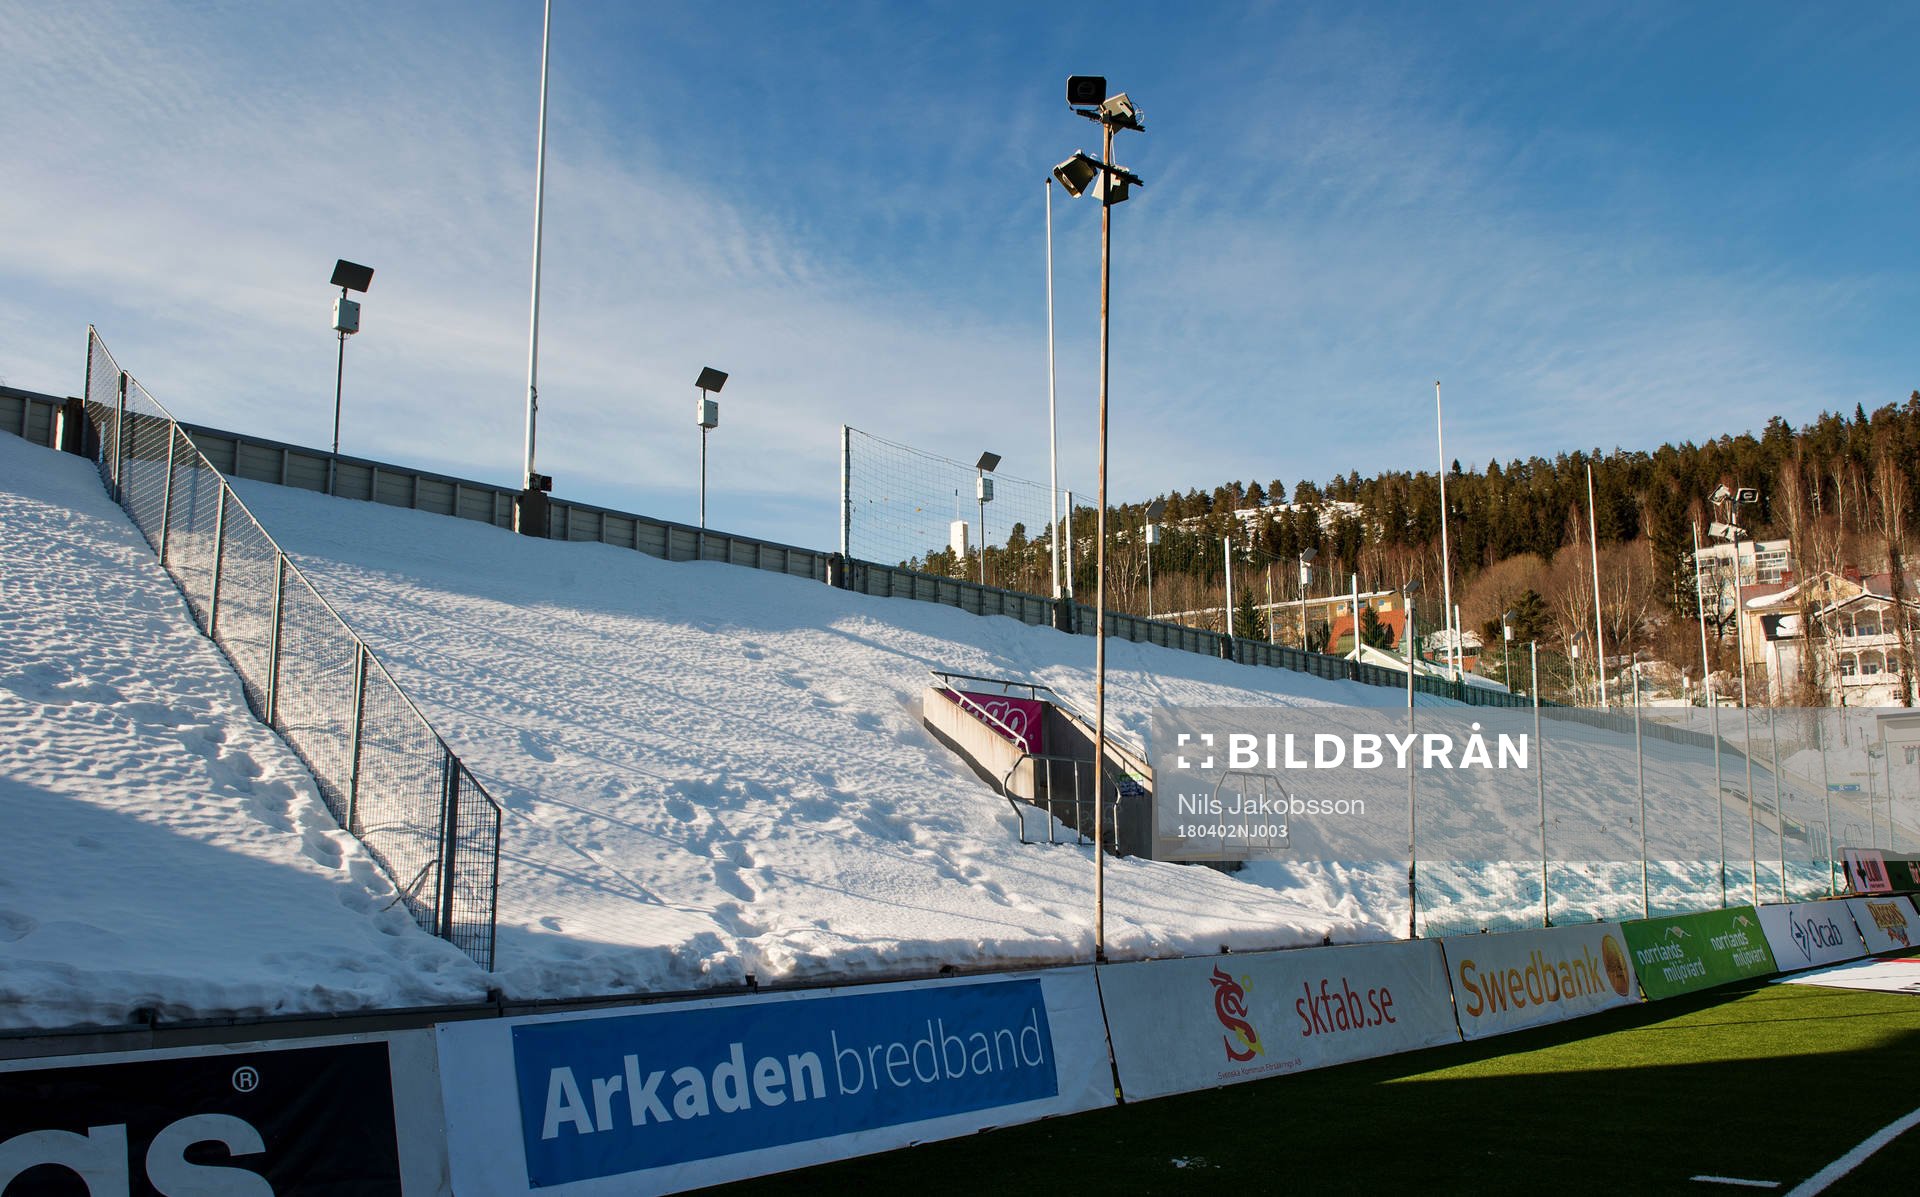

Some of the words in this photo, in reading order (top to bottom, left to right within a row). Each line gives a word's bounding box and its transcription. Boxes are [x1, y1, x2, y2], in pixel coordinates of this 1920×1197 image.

[1636, 940, 1684, 965] norrlands
[1807, 917, 1844, 949] Ocab
[1295, 978, 1397, 1037] skfab.se
[1459, 944, 1606, 1017] Swedbank
[541, 1042, 827, 1140] Arkaden
[831, 1008, 1045, 1095] bredband
